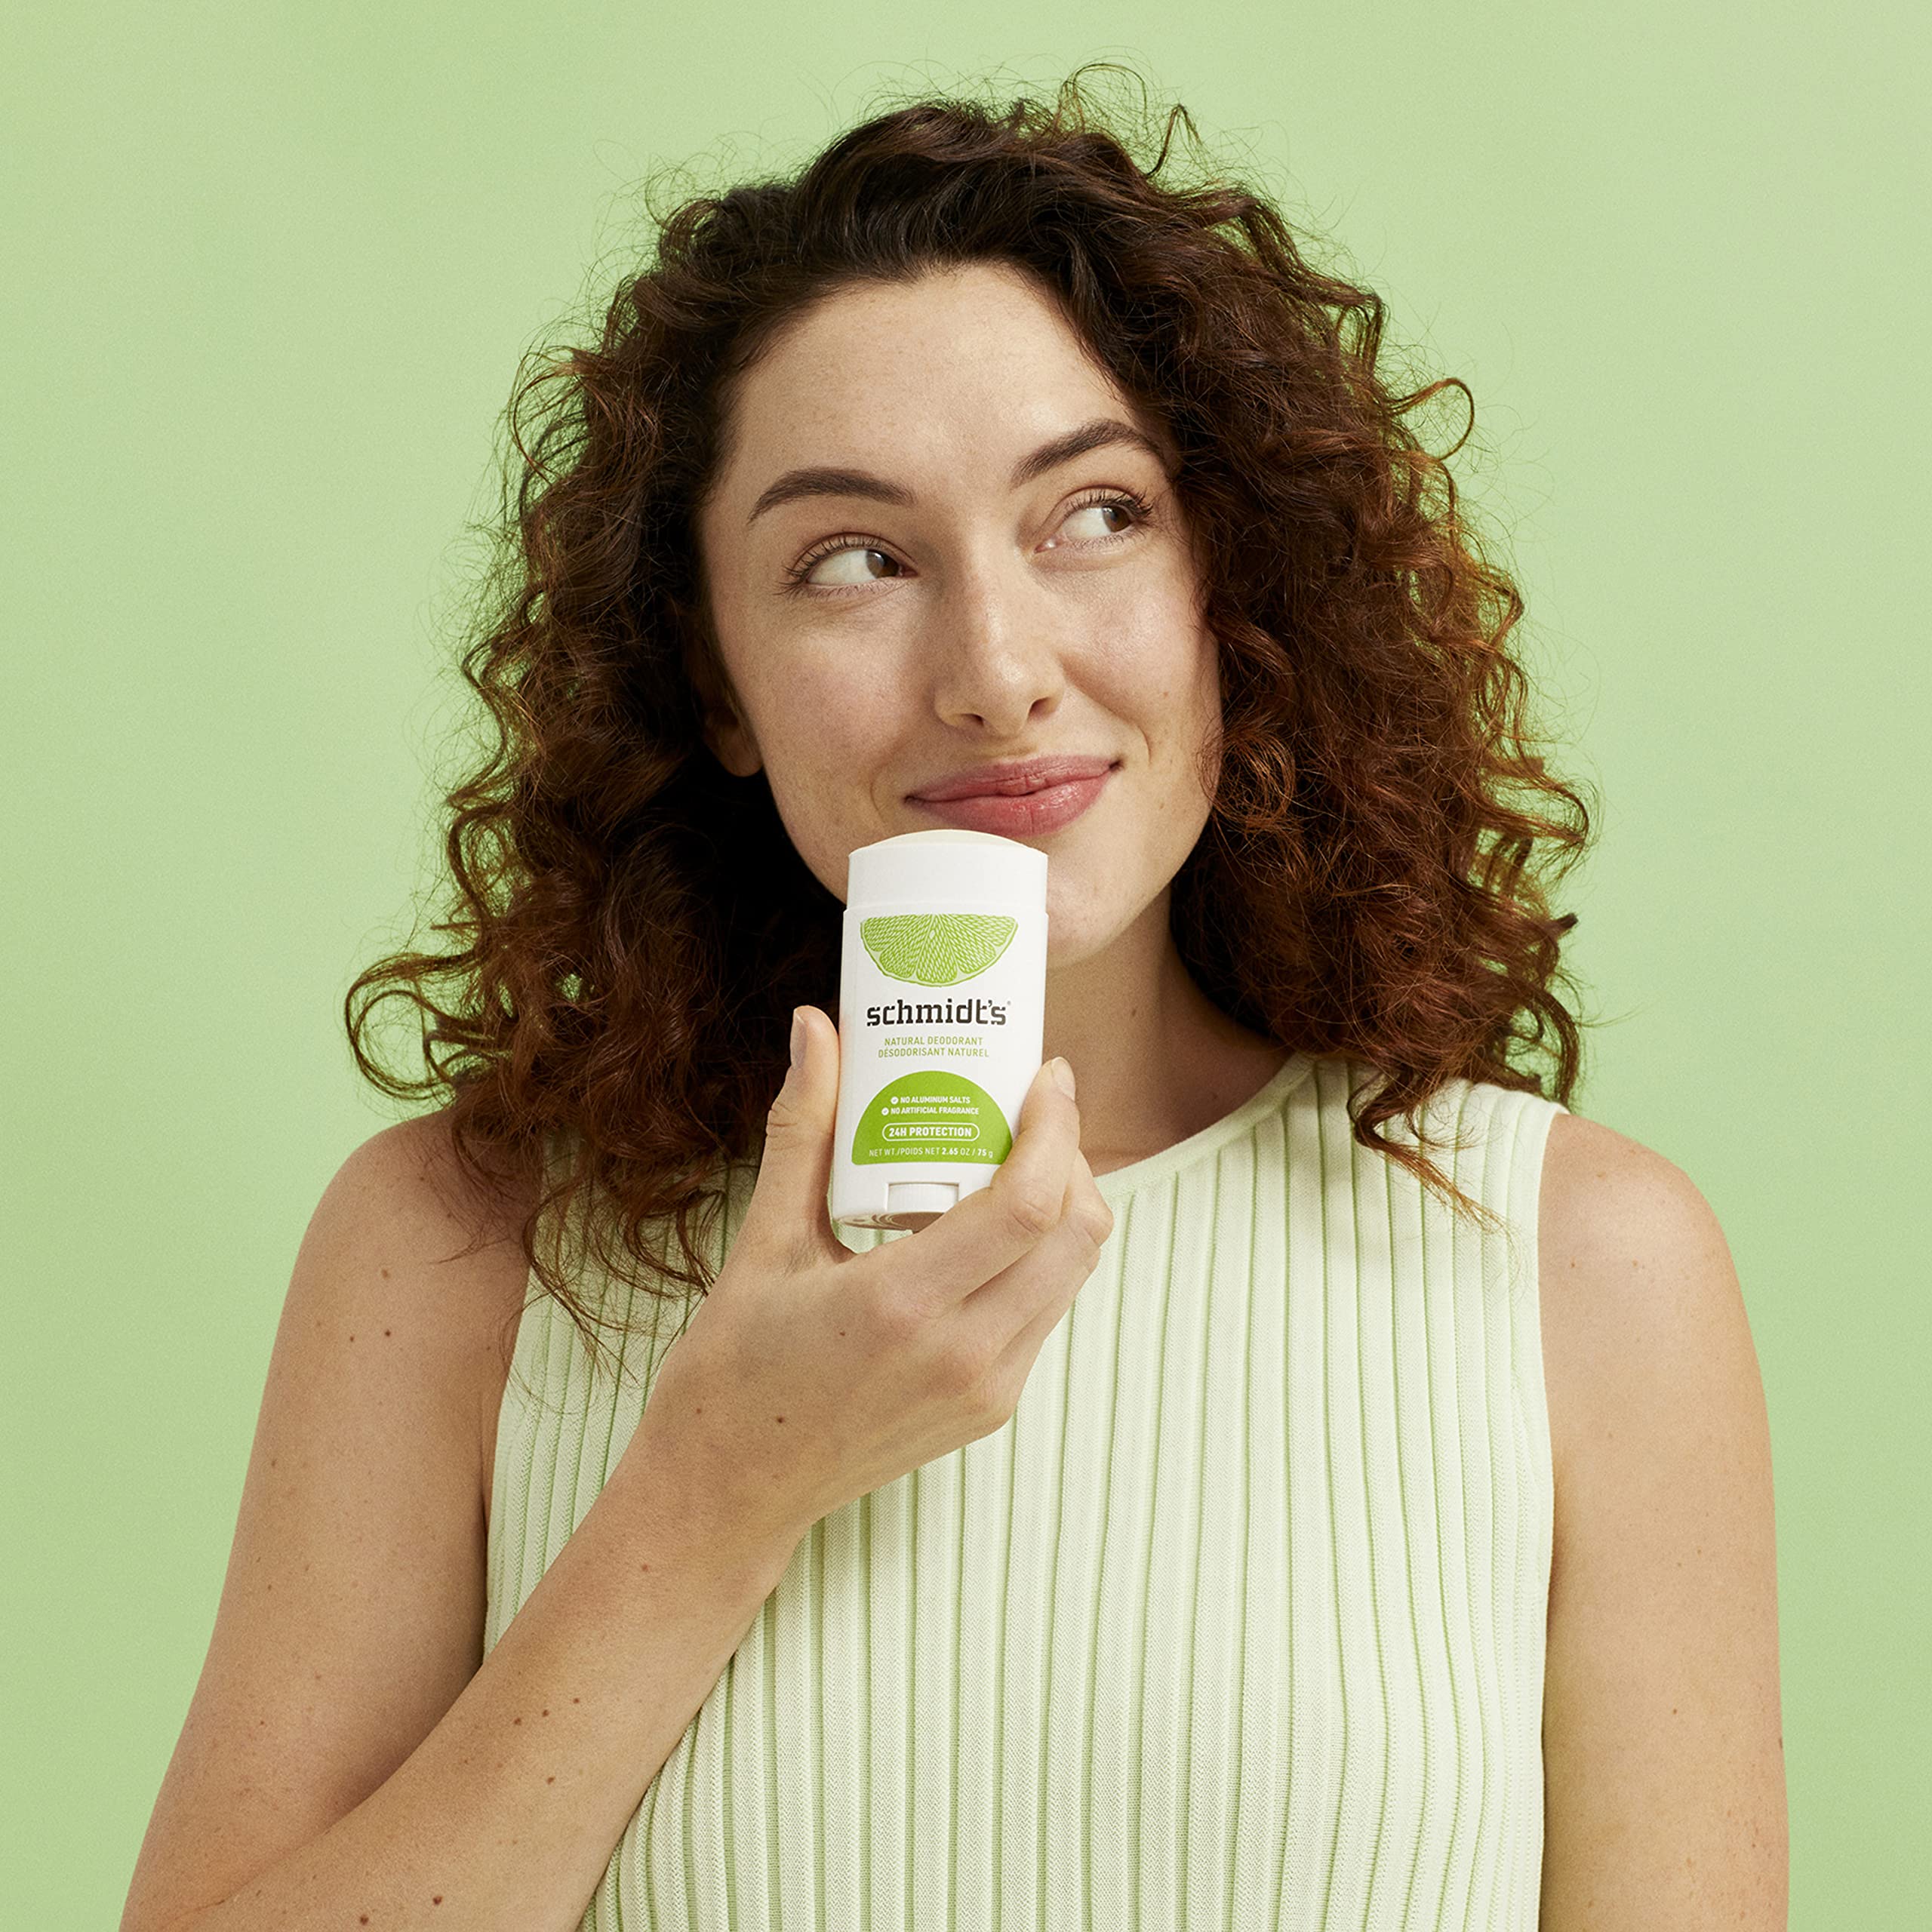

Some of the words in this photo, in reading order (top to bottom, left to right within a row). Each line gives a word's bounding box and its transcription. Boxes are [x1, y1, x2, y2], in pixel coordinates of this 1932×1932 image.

[884, 1036, 924, 1046] NATURAL
[927, 1035, 983, 1046] DEODORANT
[878, 1048, 946, 1058] DÉSODORISANT
[947, 1048, 989, 1057] NATUREL
[949, 1096, 971, 1104] SALTS
[900, 1106, 937, 1115] ARTIFICIAL
[938, 1106, 980, 1115] FRAGRANCE
[888, 1127, 907, 1137] 24H
[909, 1127, 972, 1137] PROTECTION
[869, 1149, 882, 1157] NET
[924, 1147, 940, 1155] NET
[941, 1147, 958, 1155] 2.65
[960, 1147, 970, 1156] OZ
[977, 1148, 987, 1156] 75
[988, 1150, 994, 1158] g
